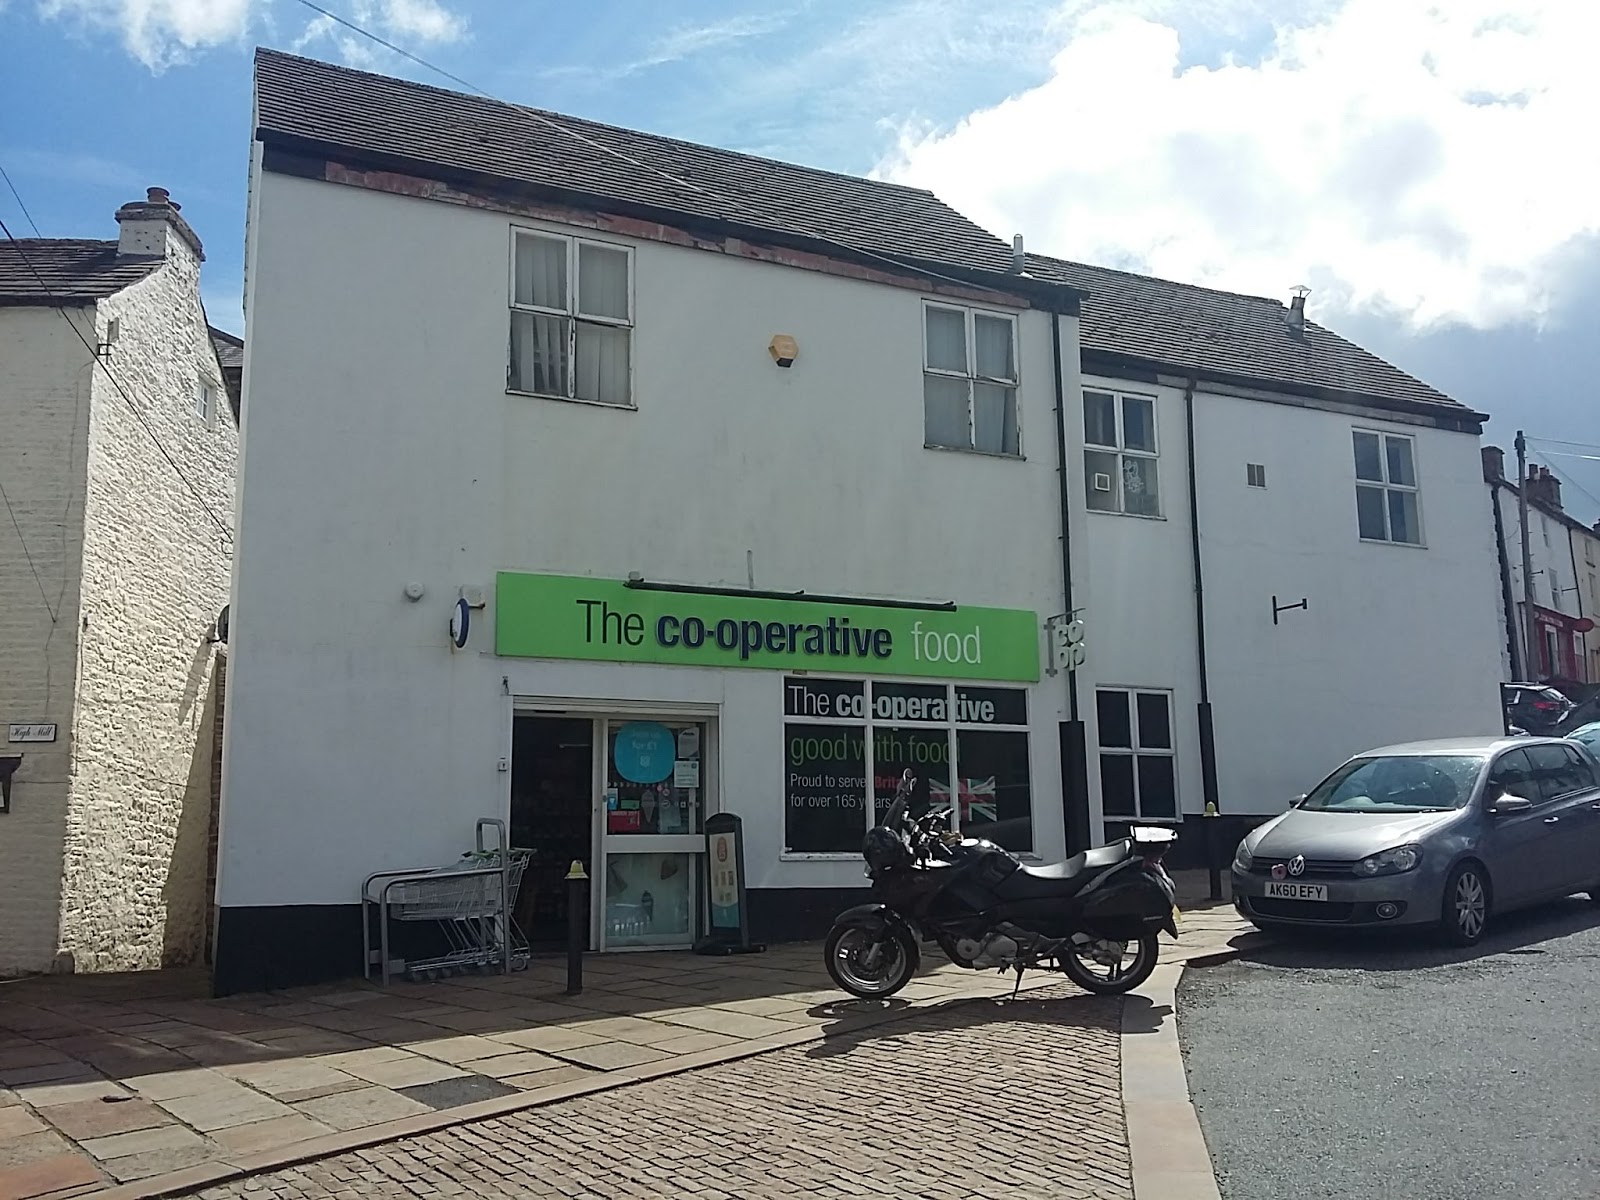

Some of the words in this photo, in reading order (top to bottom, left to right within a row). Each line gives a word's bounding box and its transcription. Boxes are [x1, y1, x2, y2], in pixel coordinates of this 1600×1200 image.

[576, 599, 644, 645] The
[655, 614, 893, 660] co-operative
[911, 621, 982, 665] food
[788, 685, 830, 715] The
[790, 733, 848, 766] good
[908, 735, 960, 764] food
[790, 773, 821, 789] Proud
[825, 775, 835, 788] to
[838, 777, 866, 789] serve
[791, 794, 803, 807] for
[808, 796, 831, 808] over
[835, 794, 856, 808] 165
[859, 796, 891, 811] yars
[1269, 883, 1297, 897] AK60
[1299, 885, 1323, 899] EFY
